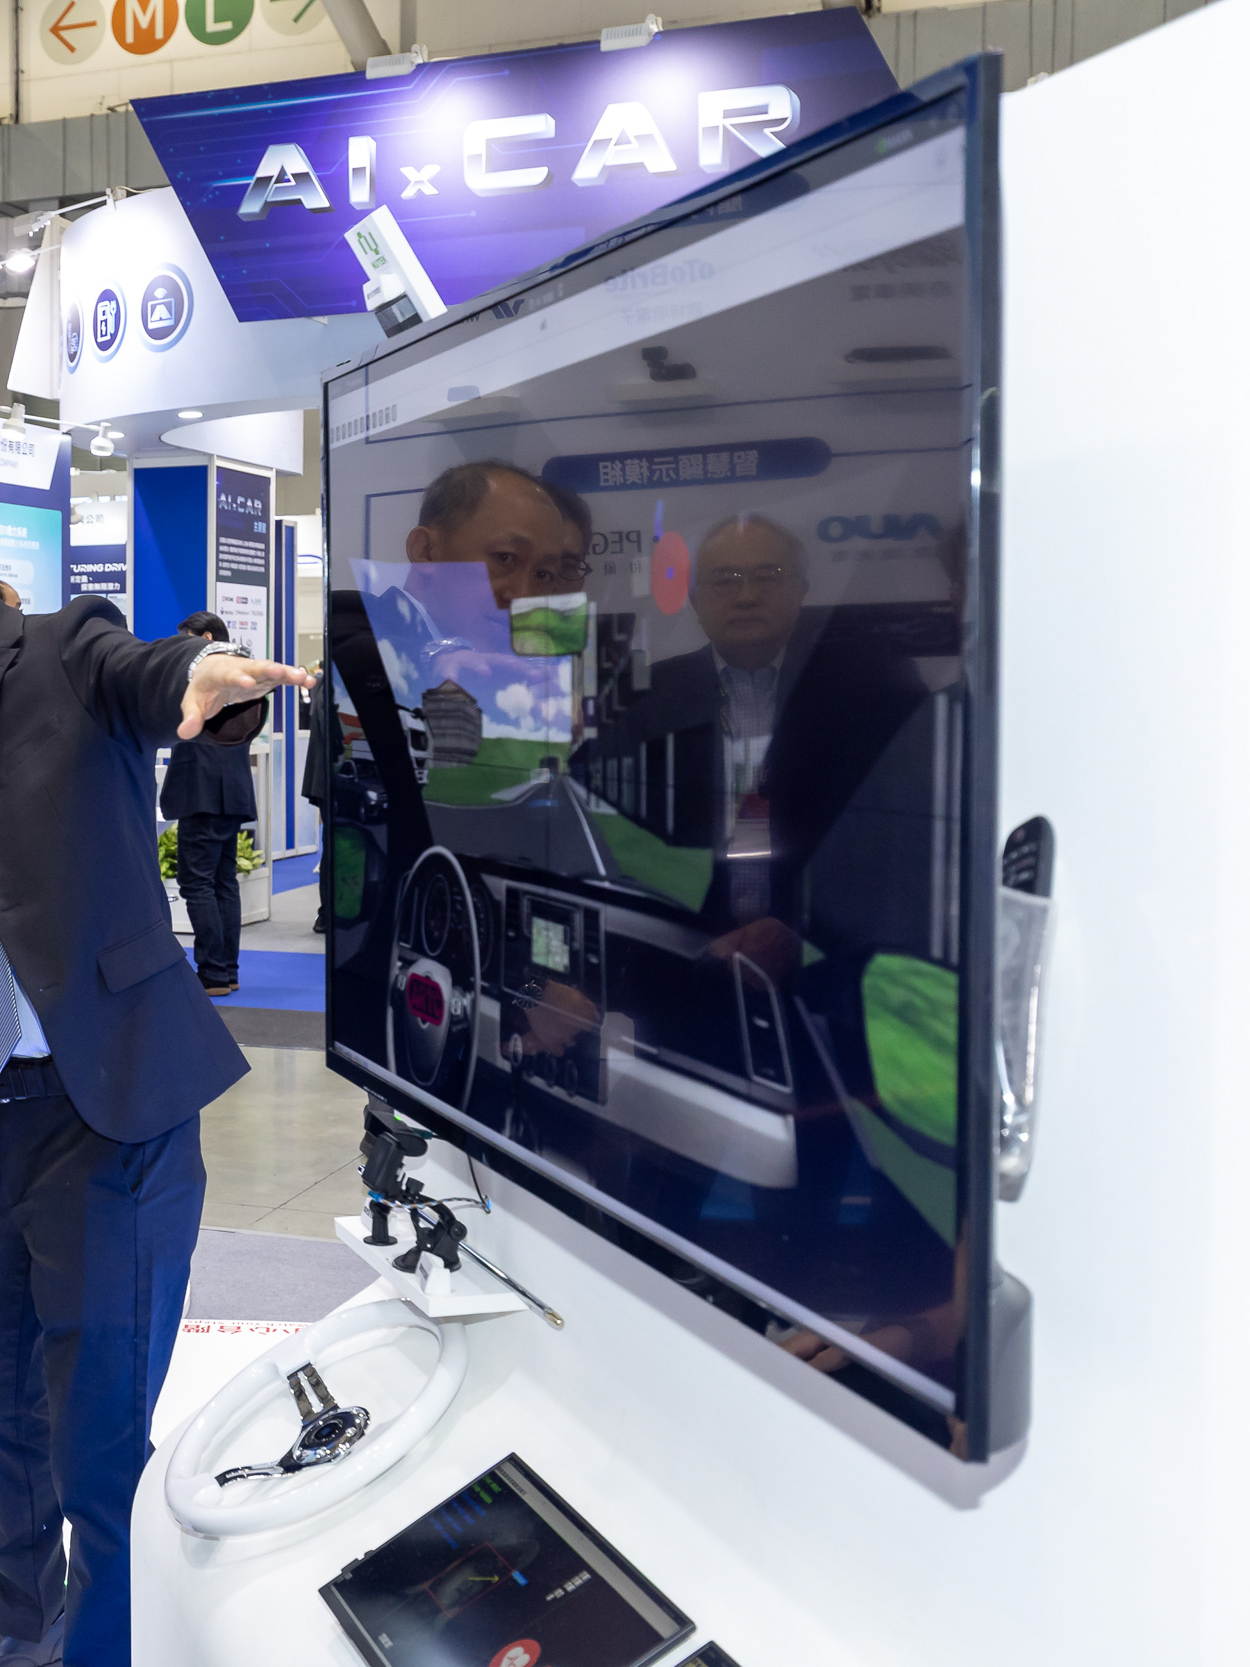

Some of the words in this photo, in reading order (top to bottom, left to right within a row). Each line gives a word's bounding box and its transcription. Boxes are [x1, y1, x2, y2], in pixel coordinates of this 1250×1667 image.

[125, 0, 164, 44] M
[205, 0, 233, 33] L
[237, 136, 377, 222] AI
[463, 84, 801, 198] CAR
